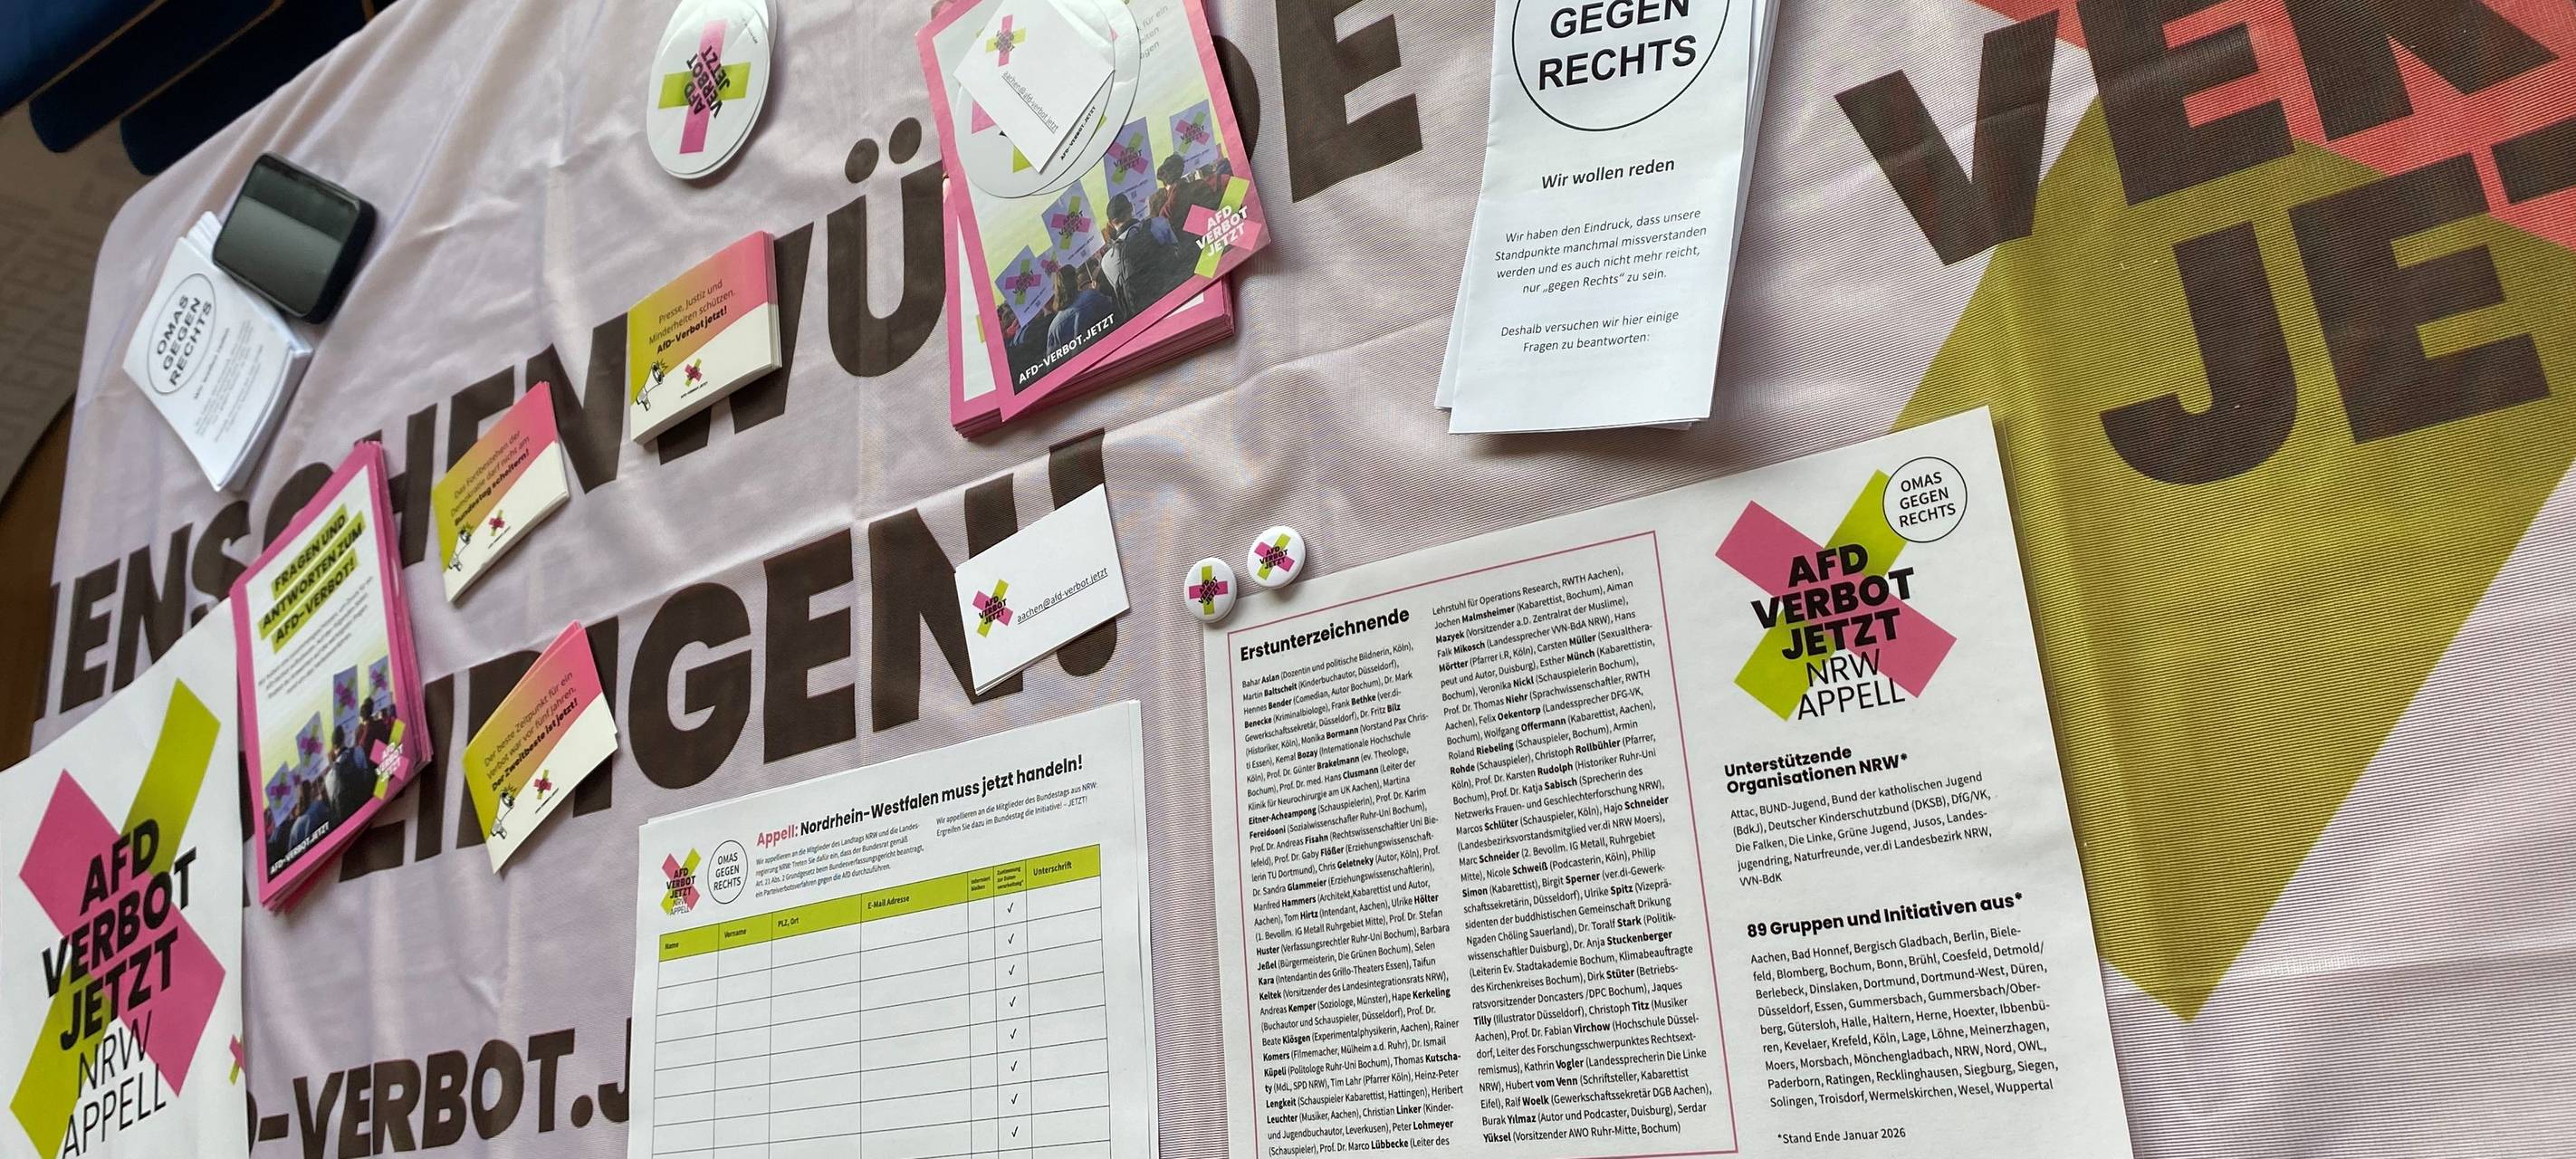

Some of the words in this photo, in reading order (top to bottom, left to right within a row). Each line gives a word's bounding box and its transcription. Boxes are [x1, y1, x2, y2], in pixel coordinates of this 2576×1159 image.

[1551, 0, 1689, 38] GEGEN
[701, 45, 731, 91] JETZT
[1538, 34, 1696, 91] RECHTS
[685, 81, 705, 114] AFD
[686, 53, 723, 119] VERBOT
[1002, 71, 1059, 132] aachen@afd-verbot.jetzt
[1541, 173, 1568, 188] Wir
[1572, 166, 1623, 184] wollen
[1628, 158, 1674, 177] reden
[1196, 206, 1248, 251] VERBOT
[1206, 205, 1232, 229] AFD
[1505, 232, 1524, 242] Wir
[1526, 228, 1557, 240] haben
[1560, 225, 1580, 235] den
[1584, 217, 1633, 233] Eindruck,
[1635, 215, 1660, 226] dass
[1663, 209, 1700, 223] unsere
[1207, 224, 1245, 256] JETZT
[1494, 245, 1560, 261] Standpunkte
[1563, 236, 1618, 253] manchmal
[1621, 226, 1706, 246] missverstanden
[1496, 265, 1535, 278] werden
[1537, 262, 1558, 273] und
[1560, 263, 1572, 272] es
[1575, 257, 1600, 270] auch
[1603, 254, 1631, 266] nicht
[1633, 250, 1662, 263] mehr
[1665, 245, 1700, 259] reicht,
[1522, 283, 1540, 293] nur
[1542, 280, 1579, 292] „gegen
[1582, 272, 1624, 286] Rechts“
[1626, 273, 1639, 282] zu
[1642, 268, 1666, 280] sein.
[649, 310, 697, 345] Minderheiten
[699, 290, 735, 314] schützen.
[658, 305, 685, 323] Presse,
[685, 290, 705, 309] Justiz
[707, 279, 723, 294] und
[157, 295, 188, 355] OMAS
[163, 298, 201, 370] GEGEN
[656, 320, 704, 355] AfD-Verbot
[704, 305, 727, 328] jetzt!
[1500, 323, 1542, 336] Deshalb
[1545, 319, 1598, 332] versuchen
[1602, 317, 1619, 328] wir
[1622, 314, 1643, 326] hier
[1646, 311, 1679, 323] einige
[169, 302, 212, 386] RECHTS
[1019, 313, 1115, 384] AFD-VERBOT.JETZT
[1523, 341, 1558, 353] Fragen
[1561, 340, 1573, 350] zu
[1576, 333, 1649, 348] beantworten:
[455, 486, 492, 526] Bundestag
[493, 448, 529, 489] scheitern!
[1899, 486, 1949, 509] GEGEN
[1901, 471, 1941, 492] OMAS
[1899, 503, 1956, 527] RECHTS
[274, 537, 321, 591] FRAGEN
[321, 514, 346, 545] UND
[1259, 549, 1288, 564] VERBOT
[1265, 557, 1286, 569] JETZT
[1266, 546, 1279, 555] AFD
[1787, 543, 1868, 588] AFD
[261, 551, 336, 629] ANTWORTEN
[339, 522, 362, 557] ZUM
[1199, 580, 1210, 594] AFD
[1199, 577, 1218, 604] VERBOT
[276, 557, 355, 644] AFD-VERBOT!
[979, 599, 1007, 618] VERBOT
[984, 596, 999, 608] AFD
[1017, 566, 1108, 624] aachen@afd-verbot.jetzt
[1206, 585, 1220, 605] JETZT
[1749, 566, 1914, 628] VERBOT
[984, 608, 1005, 624] JETZT
[1240, 608, 1409, 661] Erstunterzeichnende
[1781, 607, 1899, 659] JETZT
[1805, 648, 1879, 686] NRW
[1797, 676, 1905, 720] APPELL
[484, 750, 496, 767] Der
[497, 731, 515, 752] beste
[516, 695, 549, 733] Zeitpunkt
[549, 684, 560, 698] für
[561, 672, 573, 685] ein
[486, 754, 509, 779] Verbot
[510, 740, 522, 755] war
[523, 727, 534, 741] vor
[535, 710, 550, 729] fünf
[493, 774, 504, 791] Der
[505, 732, 545, 777] Zweitbeste
[545, 720, 557, 734] ist
[556, 697, 578, 726] jetzt!
[1724, 746, 1852, 777] Unterstützende
[1726, 764, 1856, 795] Organisationen
[757, 824, 798, 848] Appell:
[800, 792, 938, 835] Nordrhein-Westfalen
[942, 782, 979, 801] muss
[982, 771, 1013, 798] jetzt
[1016, 753, 1082, 784] handeln!
[80, 818, 159, 915] AFD
[674, 867, 689, 879] AFD
[714, 864, 739, 877] GEGEN
[717, 851, 738, 865] OMAS
[1033, 861, 1072, 876] Unterschrift
[666, 876, 695, 890] VERBOT
[669, 886, 692, 898] JETZT
[713, 876, 742, 890] RECHTS
[867, 898, 886, 909] E-Mail
[886, 895, 910, 906] Adresse
[1747, 922, 1767, 937] 89
[1769, 916, 1843, 935] Gruppen
[1846, 908, 1882, 926] und
[1883, 900, 1977, 922] Initiativen
[42, 847, 196, 998] VERBOT
[1750, 952, 1789, 963] Aachen,
[1791, 947, 1811, 960] Bad
[1812, 943, 1852, 957] Honnef,
[1853, 938, 1897, 953] Bergisch
[1898, 933, 1951, 948] Gladbach,
[1952, 929, 1987, 942] Berlin,
[1989, 925, 2021, 938] Biele-
[60, 926, 179, 1050] JETZT
[78, 1011, 152, 1099] NRW
[62, 1063, 167, 1159] APPELL
[1814, 1130, 1840, 1142] Ende
[1843, 1130, 1878, 1140] Januar
[1880, 1126, 1905, 1138] 2026
